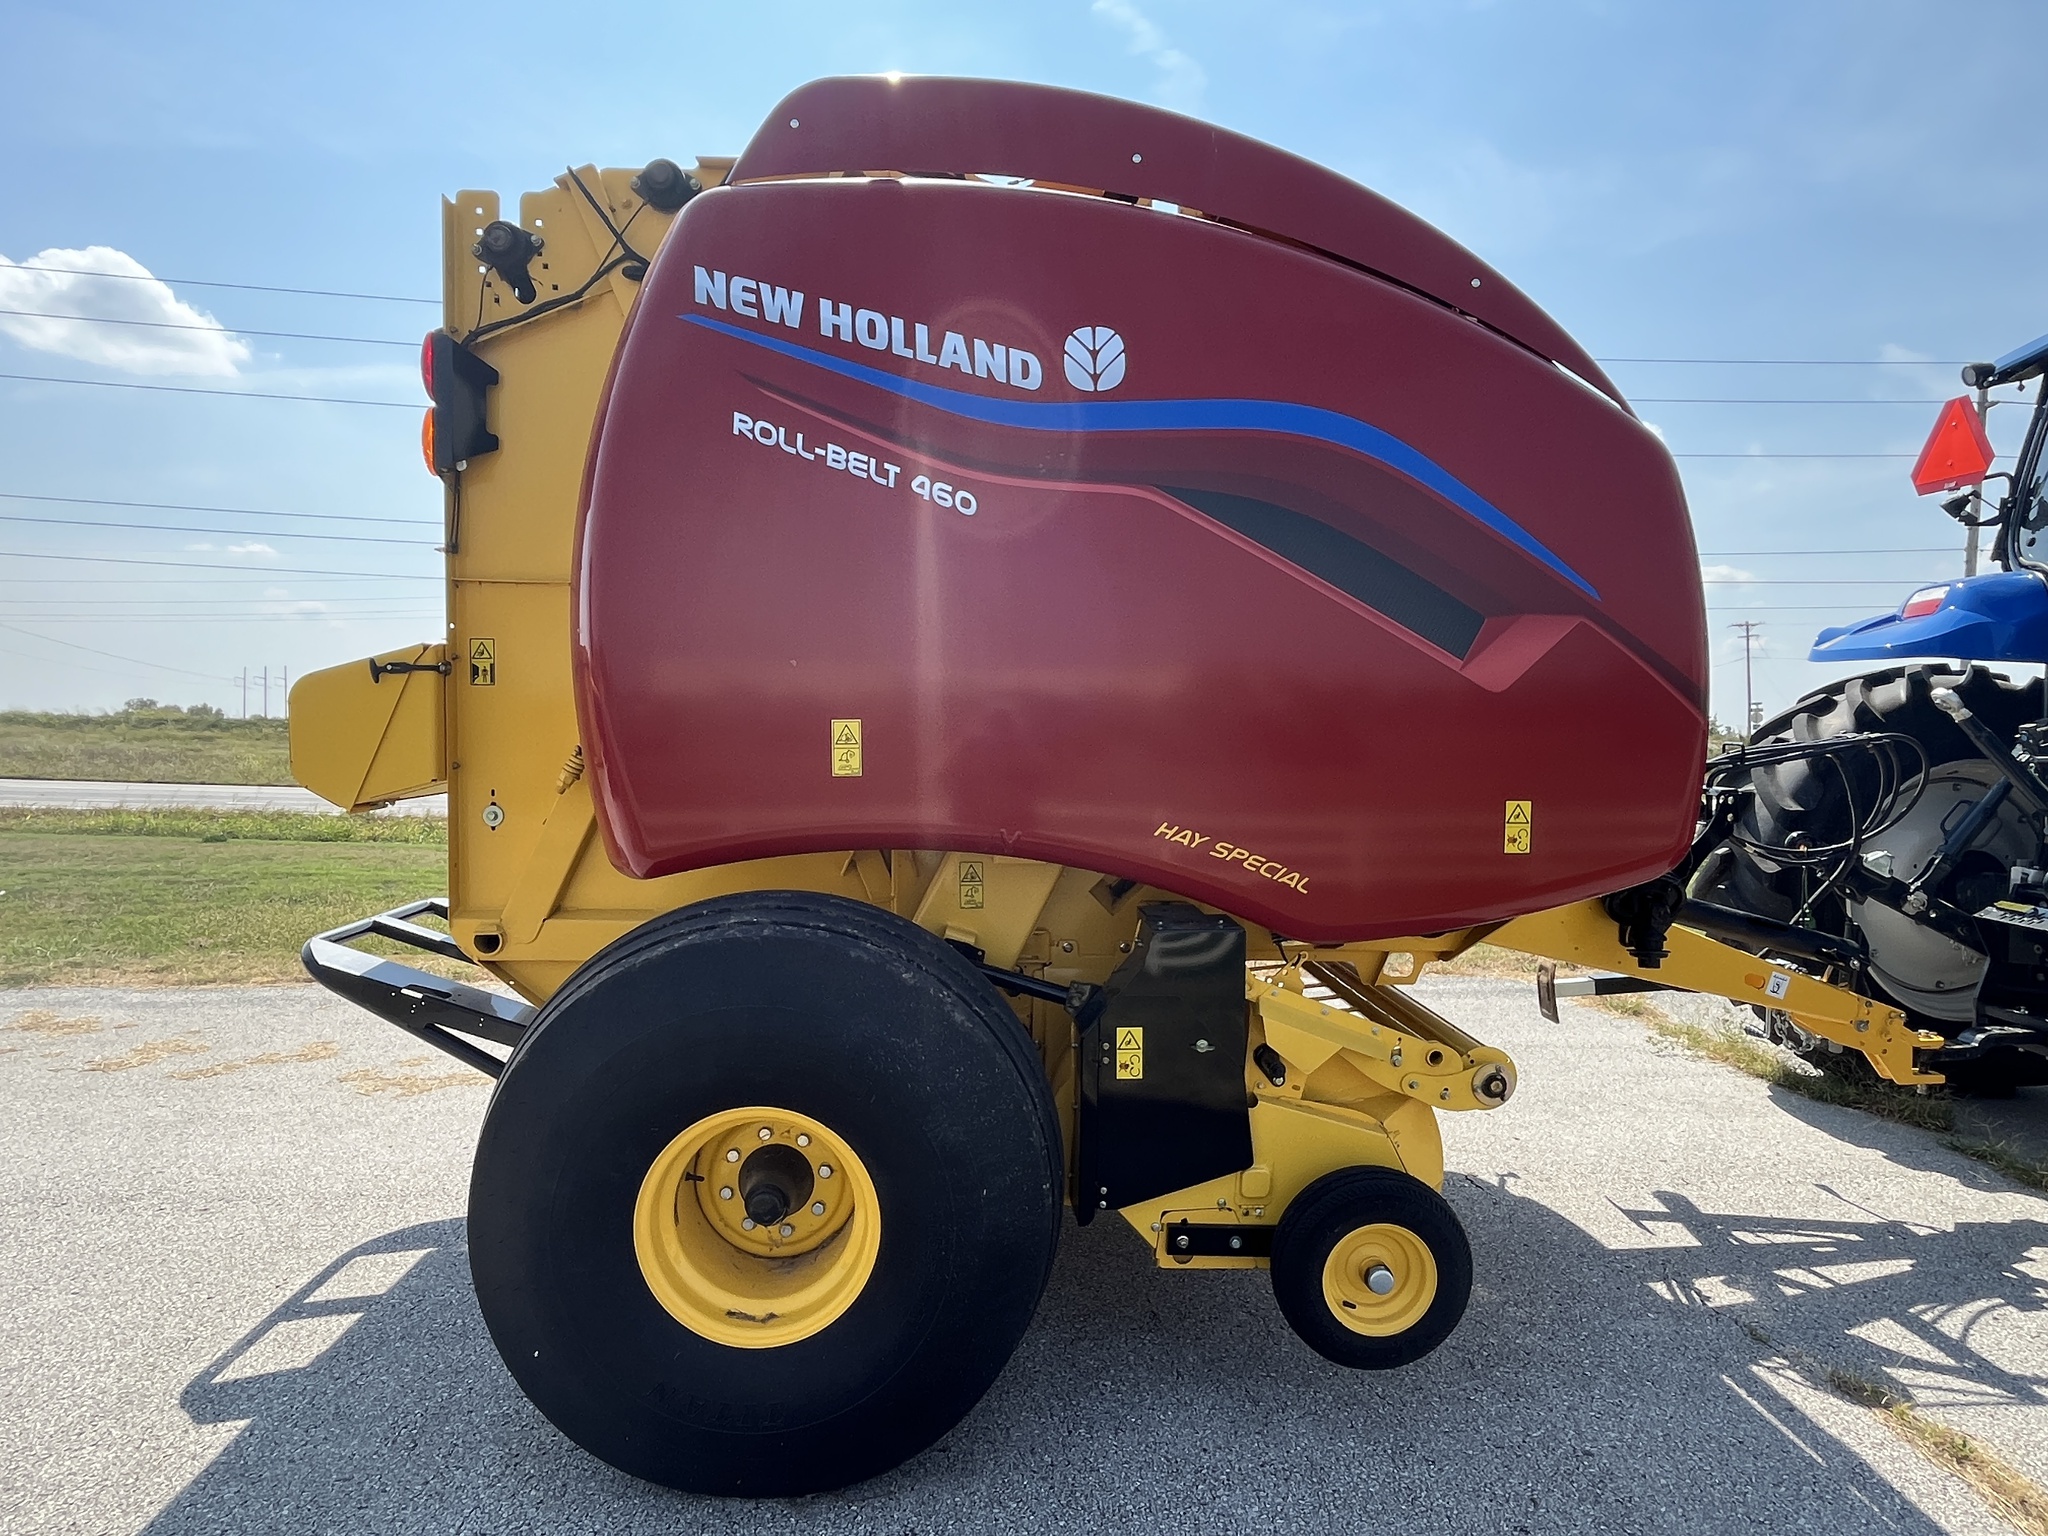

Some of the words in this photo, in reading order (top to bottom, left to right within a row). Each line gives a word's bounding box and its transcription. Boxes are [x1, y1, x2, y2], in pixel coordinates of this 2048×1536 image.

[693, 265, 804, 328] NEW
[819, 297, 1042, 391] HOLLAND
[732, 411, 900, 489] ROLL-BELT
[911, 475, 977, 516] 460
[1154, 821, 1210, 848] HAY
[1209, 842, 1309, 894] SPECIAL
